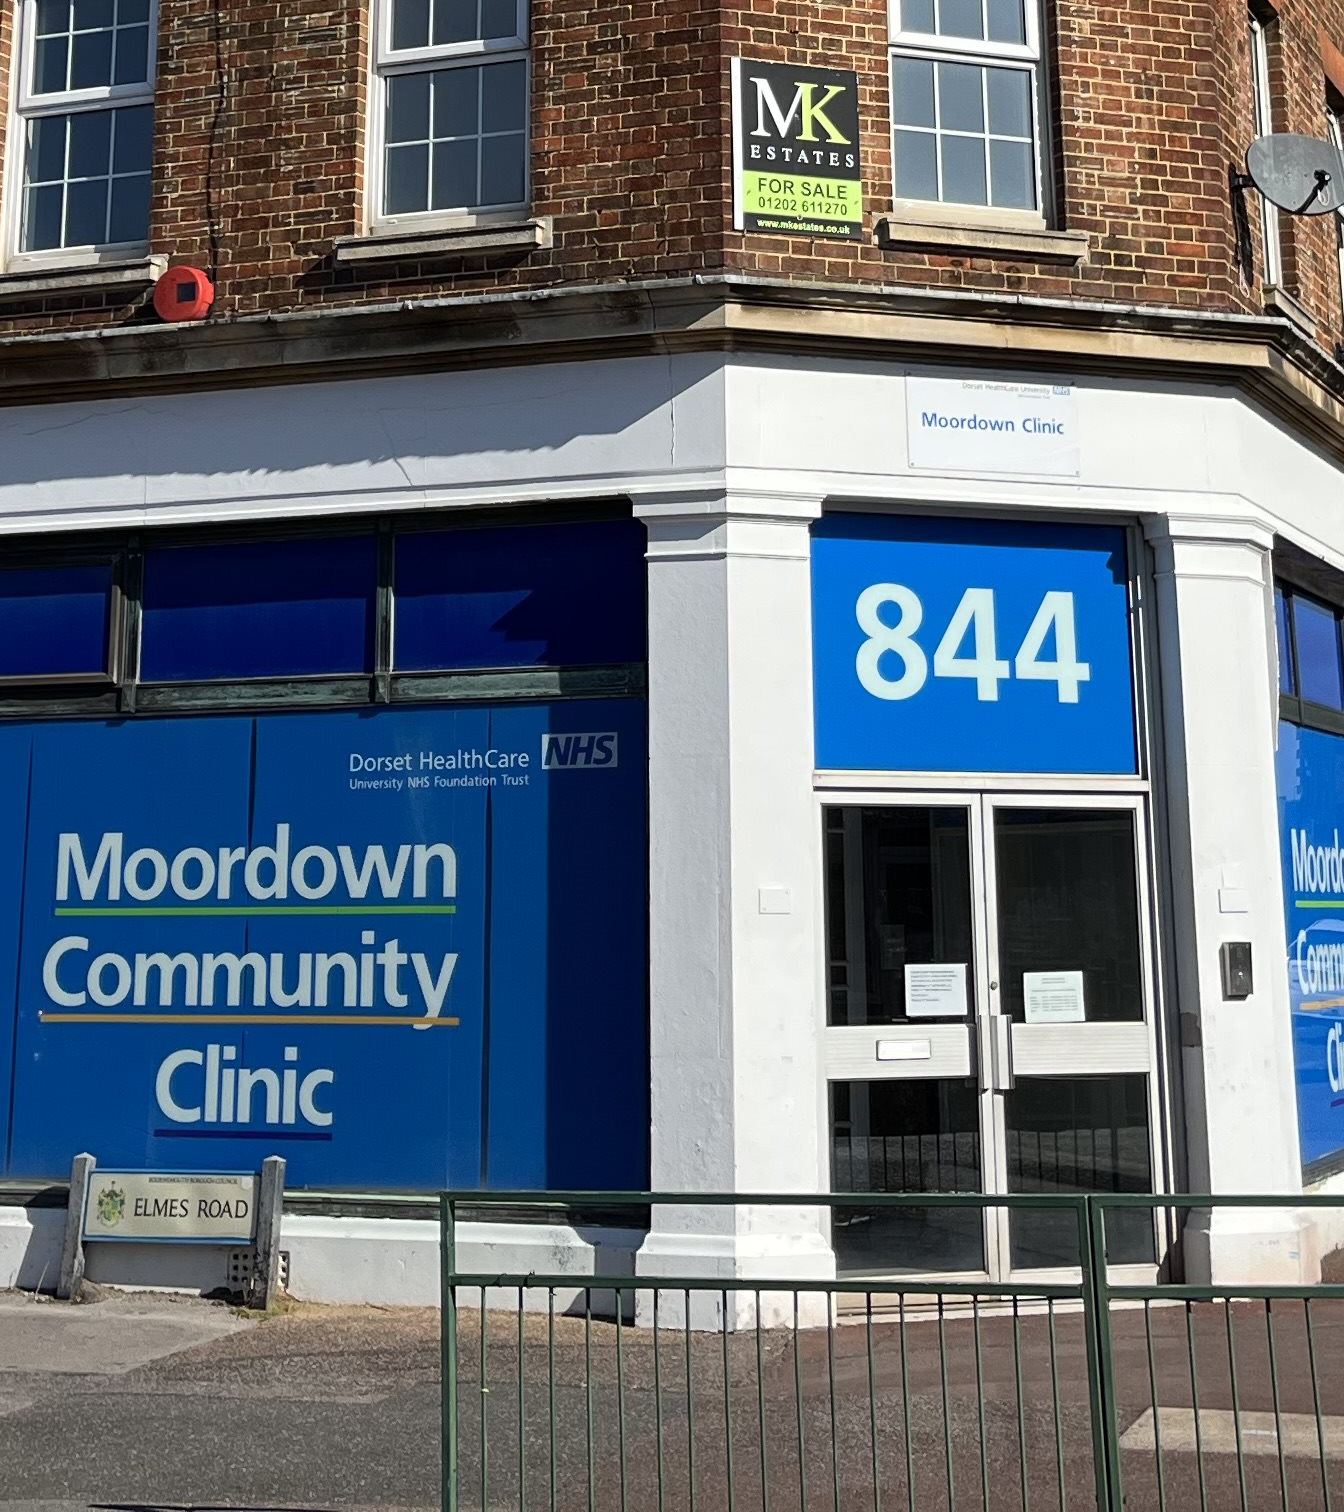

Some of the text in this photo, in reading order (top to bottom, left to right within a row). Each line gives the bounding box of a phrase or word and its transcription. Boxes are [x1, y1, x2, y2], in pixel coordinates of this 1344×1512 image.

[749, 77, 851, 145] MK
[750, 144, 855, 168] ESTATES
[757, 177, 848, 200] FOR SALE
[758, 196, 848, 216] 01202 611270
[757, 218, 851, 235] www.mkestates.co.uk
[921, 412, 1065, 435] Moordown Clinic
[855, 582, 1092, 704] 844
[349, 734, 616, 772] Dorset HealthCare NHS
[349, 773, 529, 791] University NHS Foundation Trust
[55, 823, 457, 902] Moordown
[42, 930, 459, 1030] Community
[154, 1044, 335, 1127] Clinic
[133, 1197, 249, 1219] ELMES ROAD
